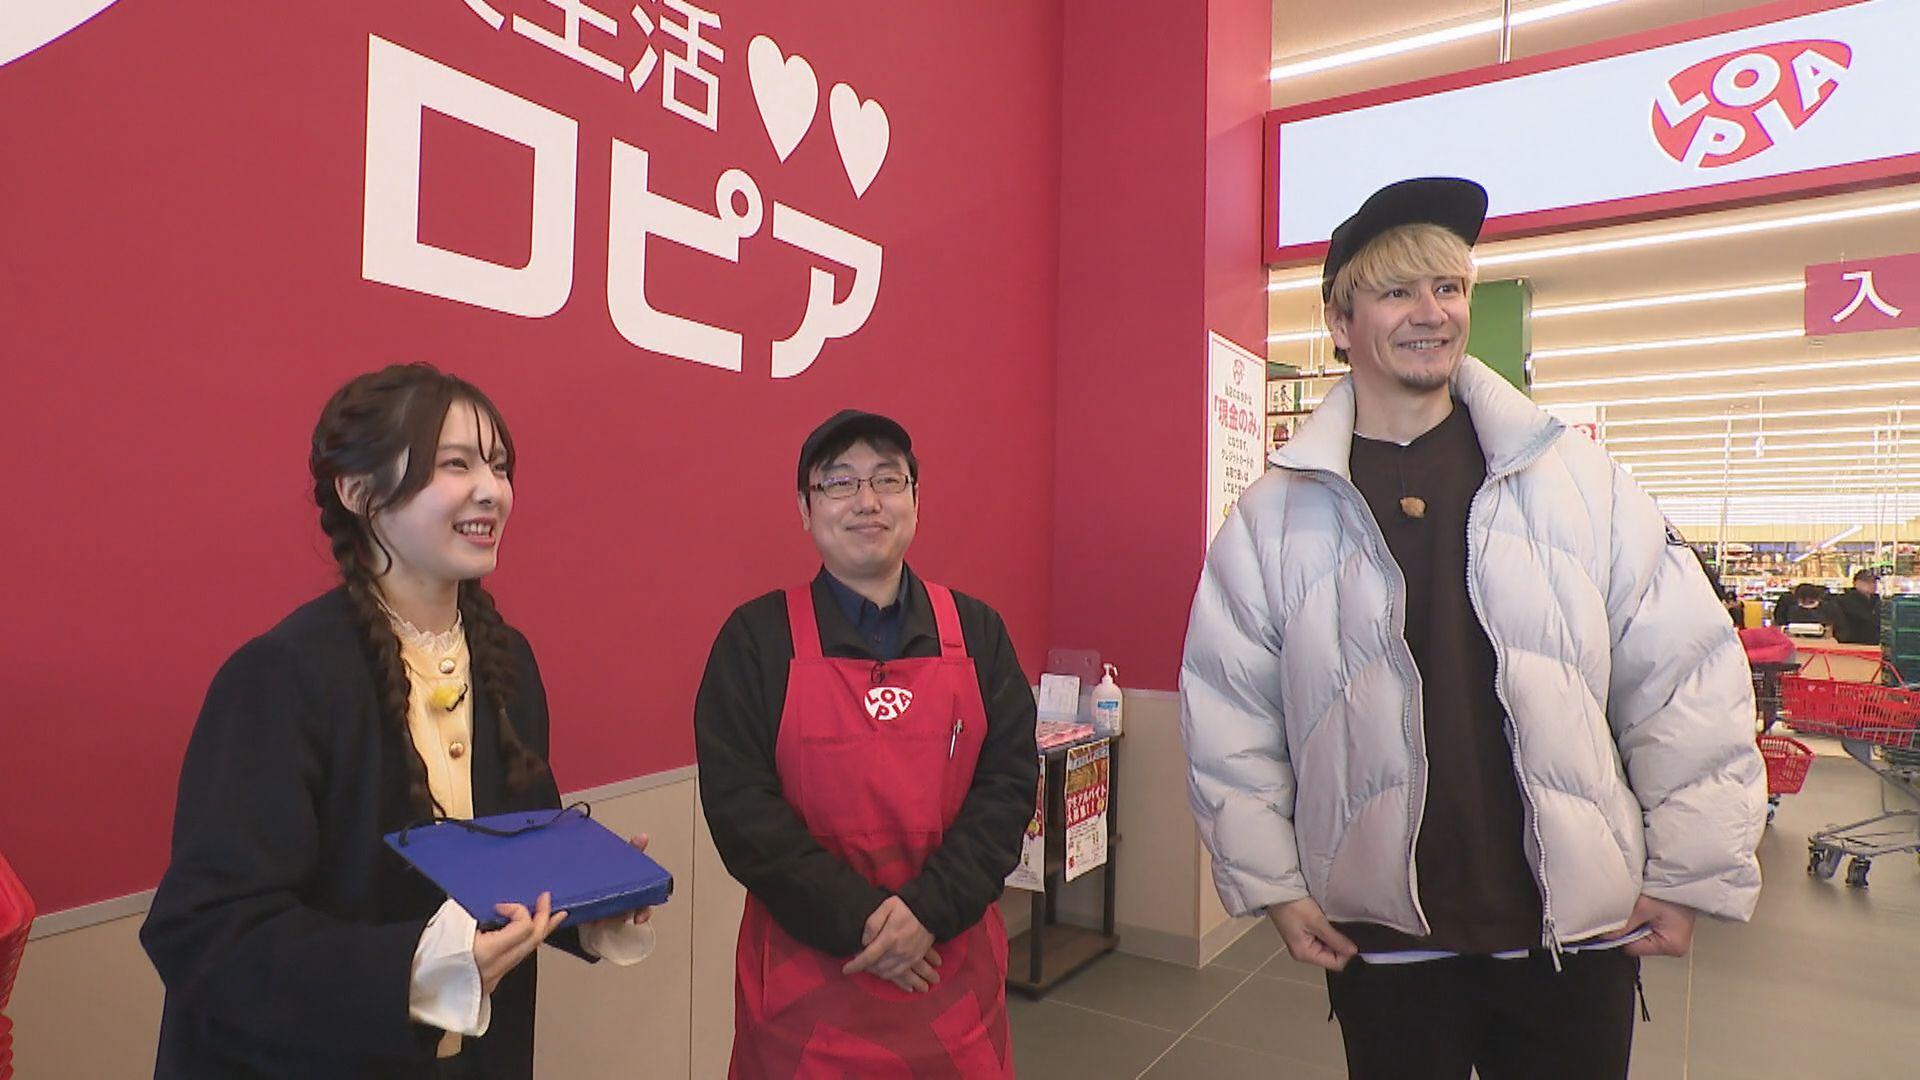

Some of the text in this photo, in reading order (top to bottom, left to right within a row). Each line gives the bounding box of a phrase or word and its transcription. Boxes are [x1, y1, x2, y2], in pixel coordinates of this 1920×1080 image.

[463, 0, 724, 132] 生活
[1653, 44, 1850, 169] LOPIA
[361, 33, 883, 379] ロピア
[1831, 271, 1903, 323] 入
[1214, 394, 1261, 441] 「現金のみ」
[865, 688, 913, 721] LOPIA
